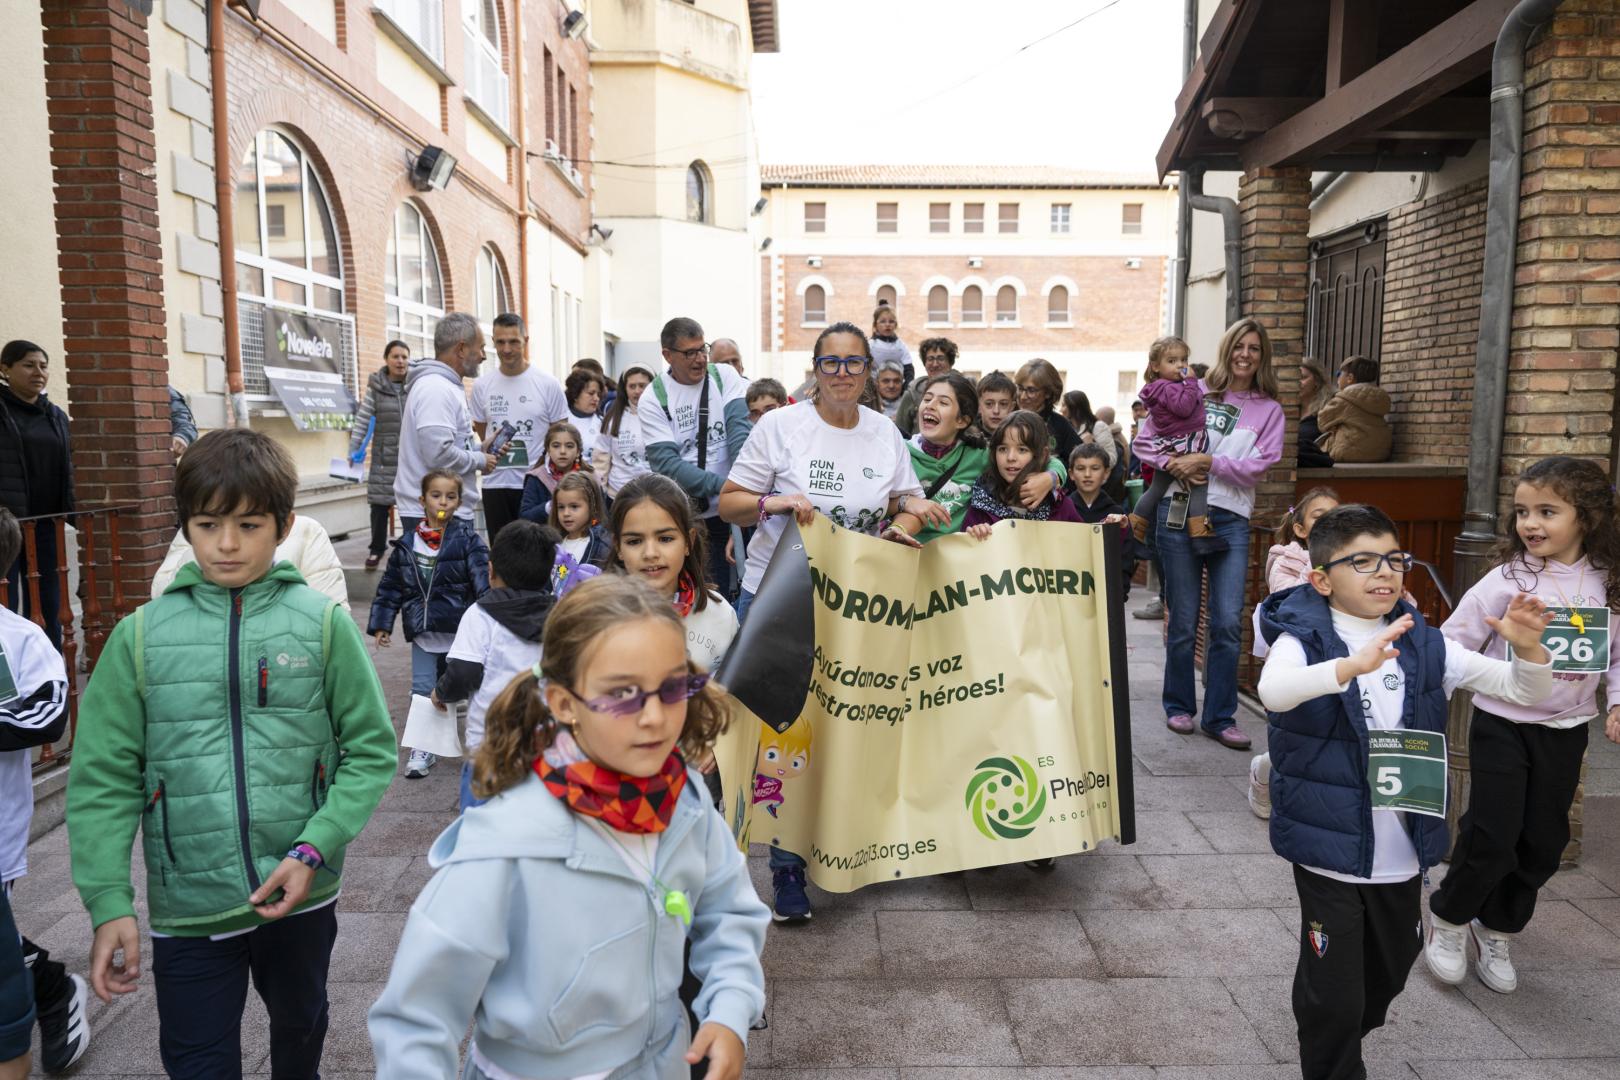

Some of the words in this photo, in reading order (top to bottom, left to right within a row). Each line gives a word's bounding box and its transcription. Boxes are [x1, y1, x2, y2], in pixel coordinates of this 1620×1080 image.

[676, 404, 692, 415] RUN
[677, 412, 695, 422] LIKE
[506, 452, 516, 463] 7
[810, 460, 834, 470] RUN
[809, 470, 834, 481] LIKE
[837, 473, 845, 481] A
[809, 480, 843, 492] HERO
[1546, 636, 1594, 662] 26
[927, 654, 963, 678] voz
[919, 672, 1005, 711] héroes!
[1405, 744, 1428, 752] SOCIAL
[1037, 756, 1055, 767] ES
[1376, 766, 1403, 796] 5
